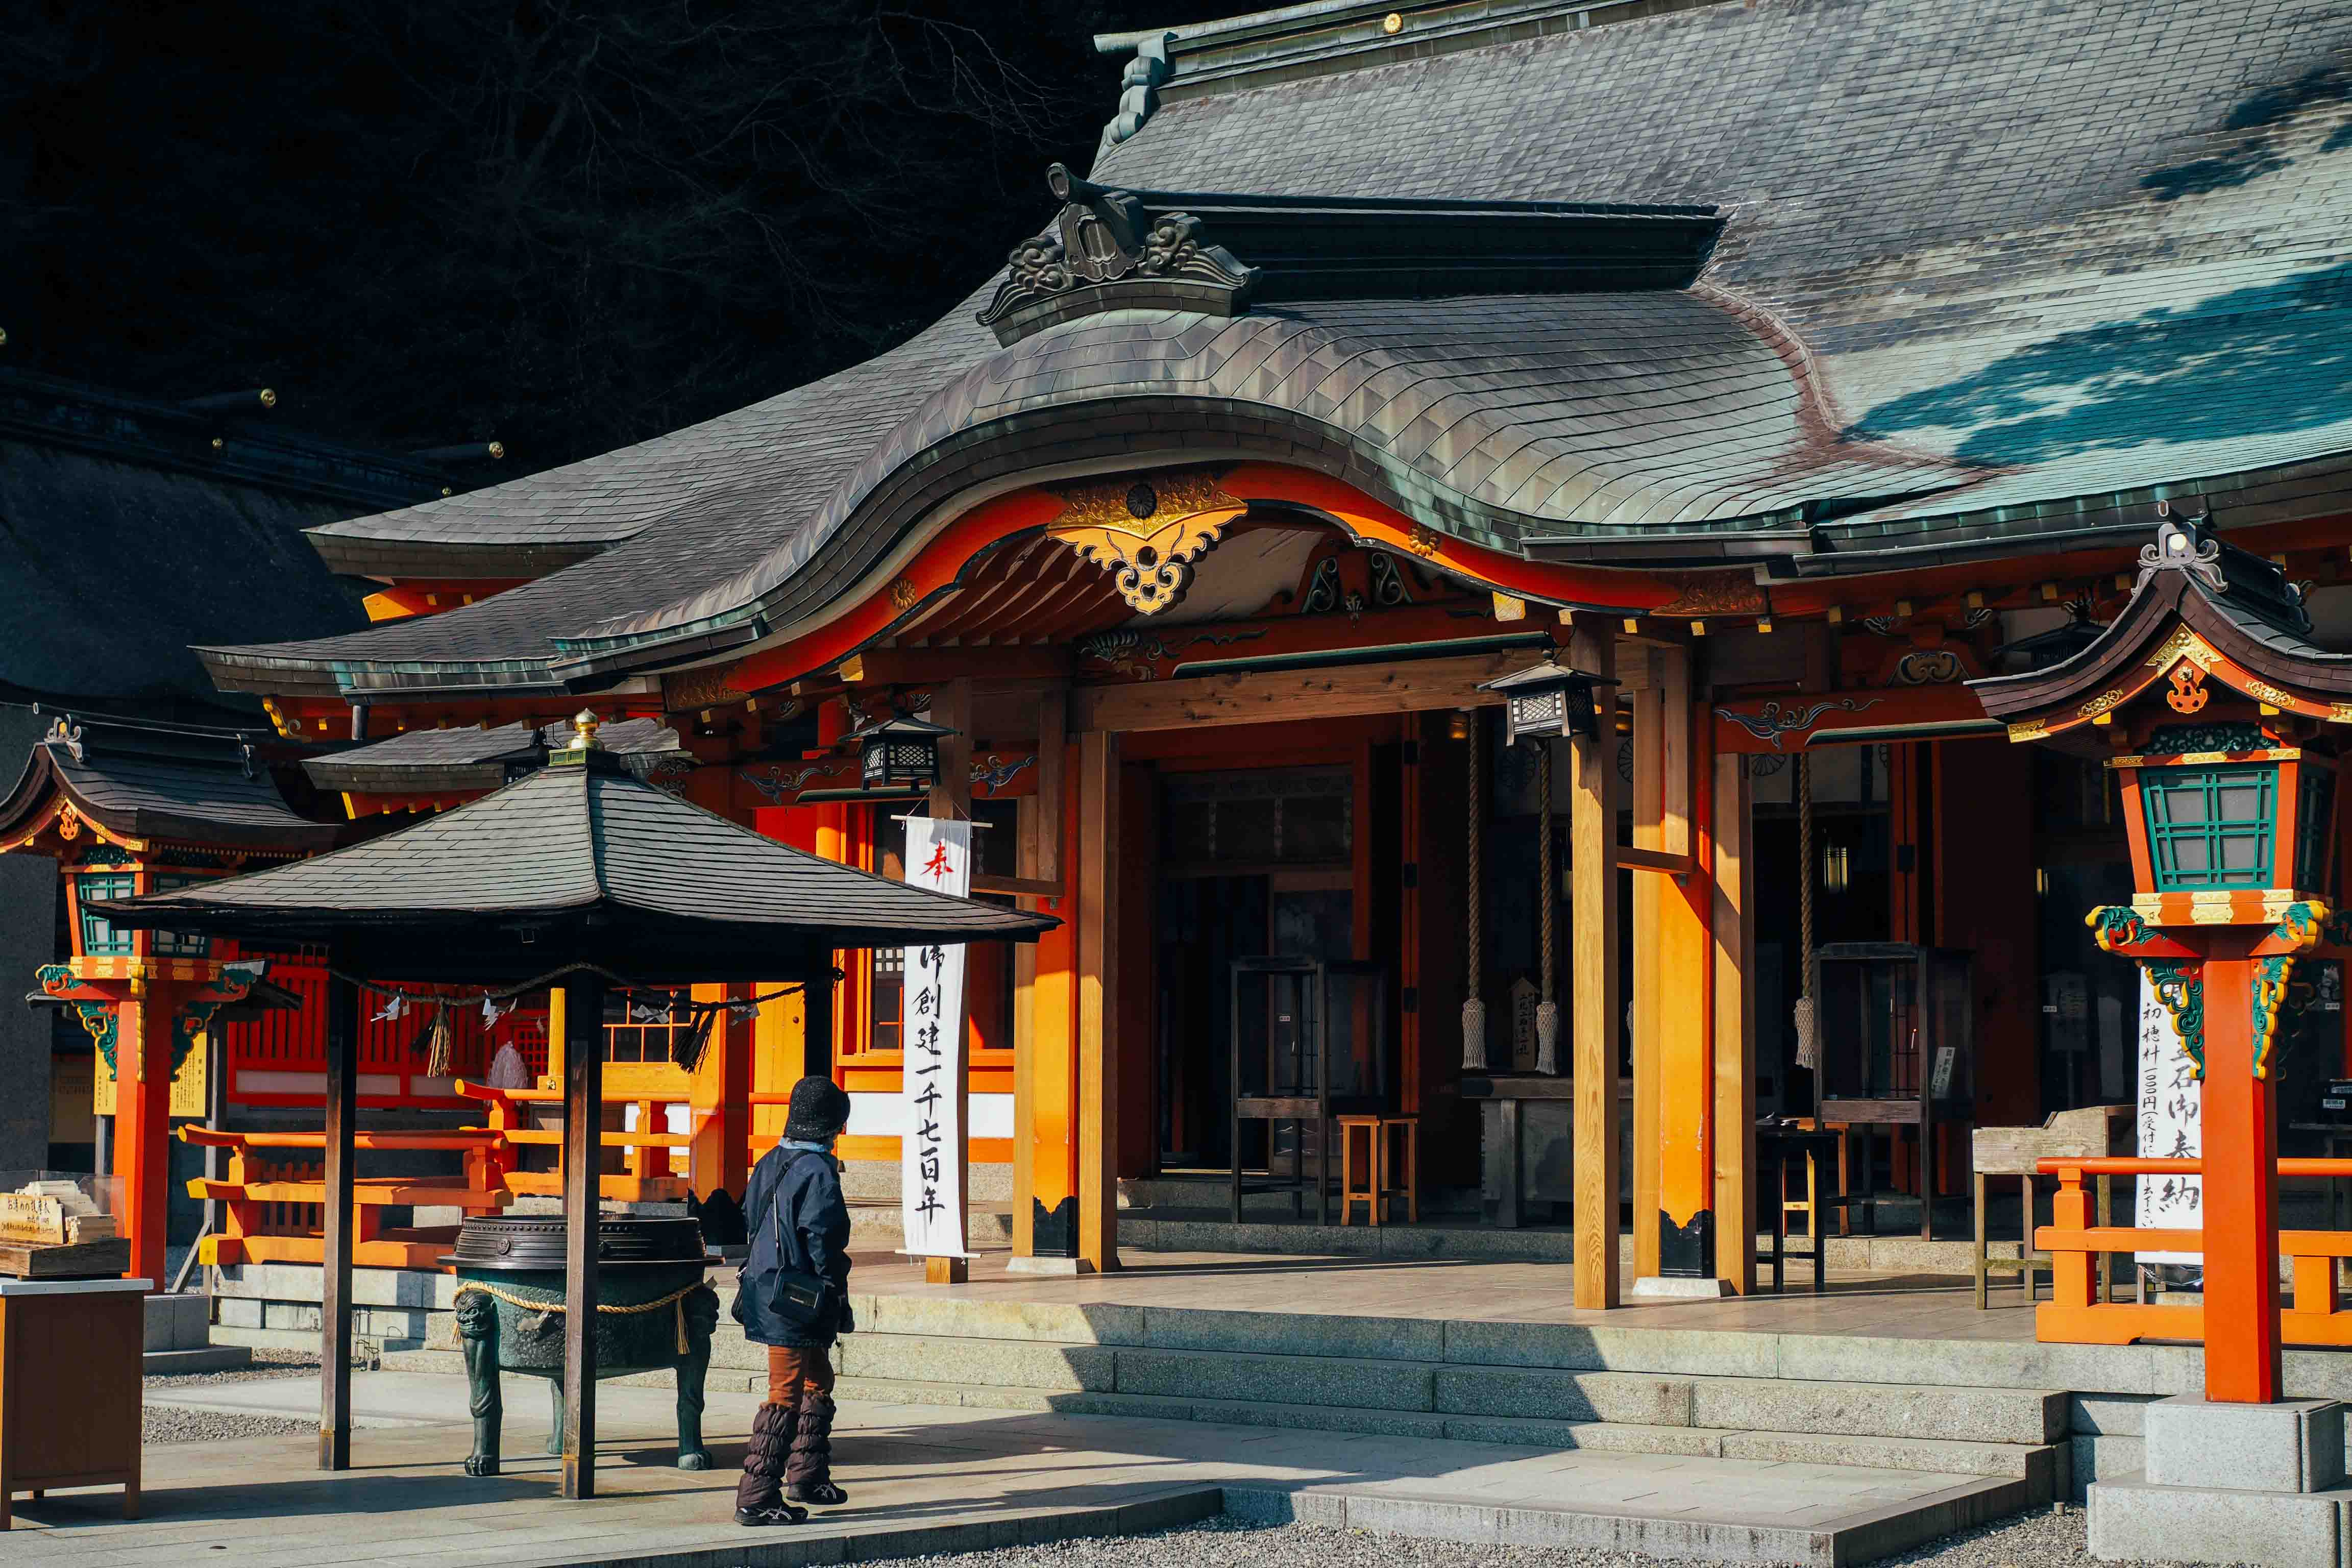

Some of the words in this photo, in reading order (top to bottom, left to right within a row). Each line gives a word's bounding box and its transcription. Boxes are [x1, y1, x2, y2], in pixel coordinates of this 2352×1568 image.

[912, 945, 946, 1226] 御創建一千七百年
